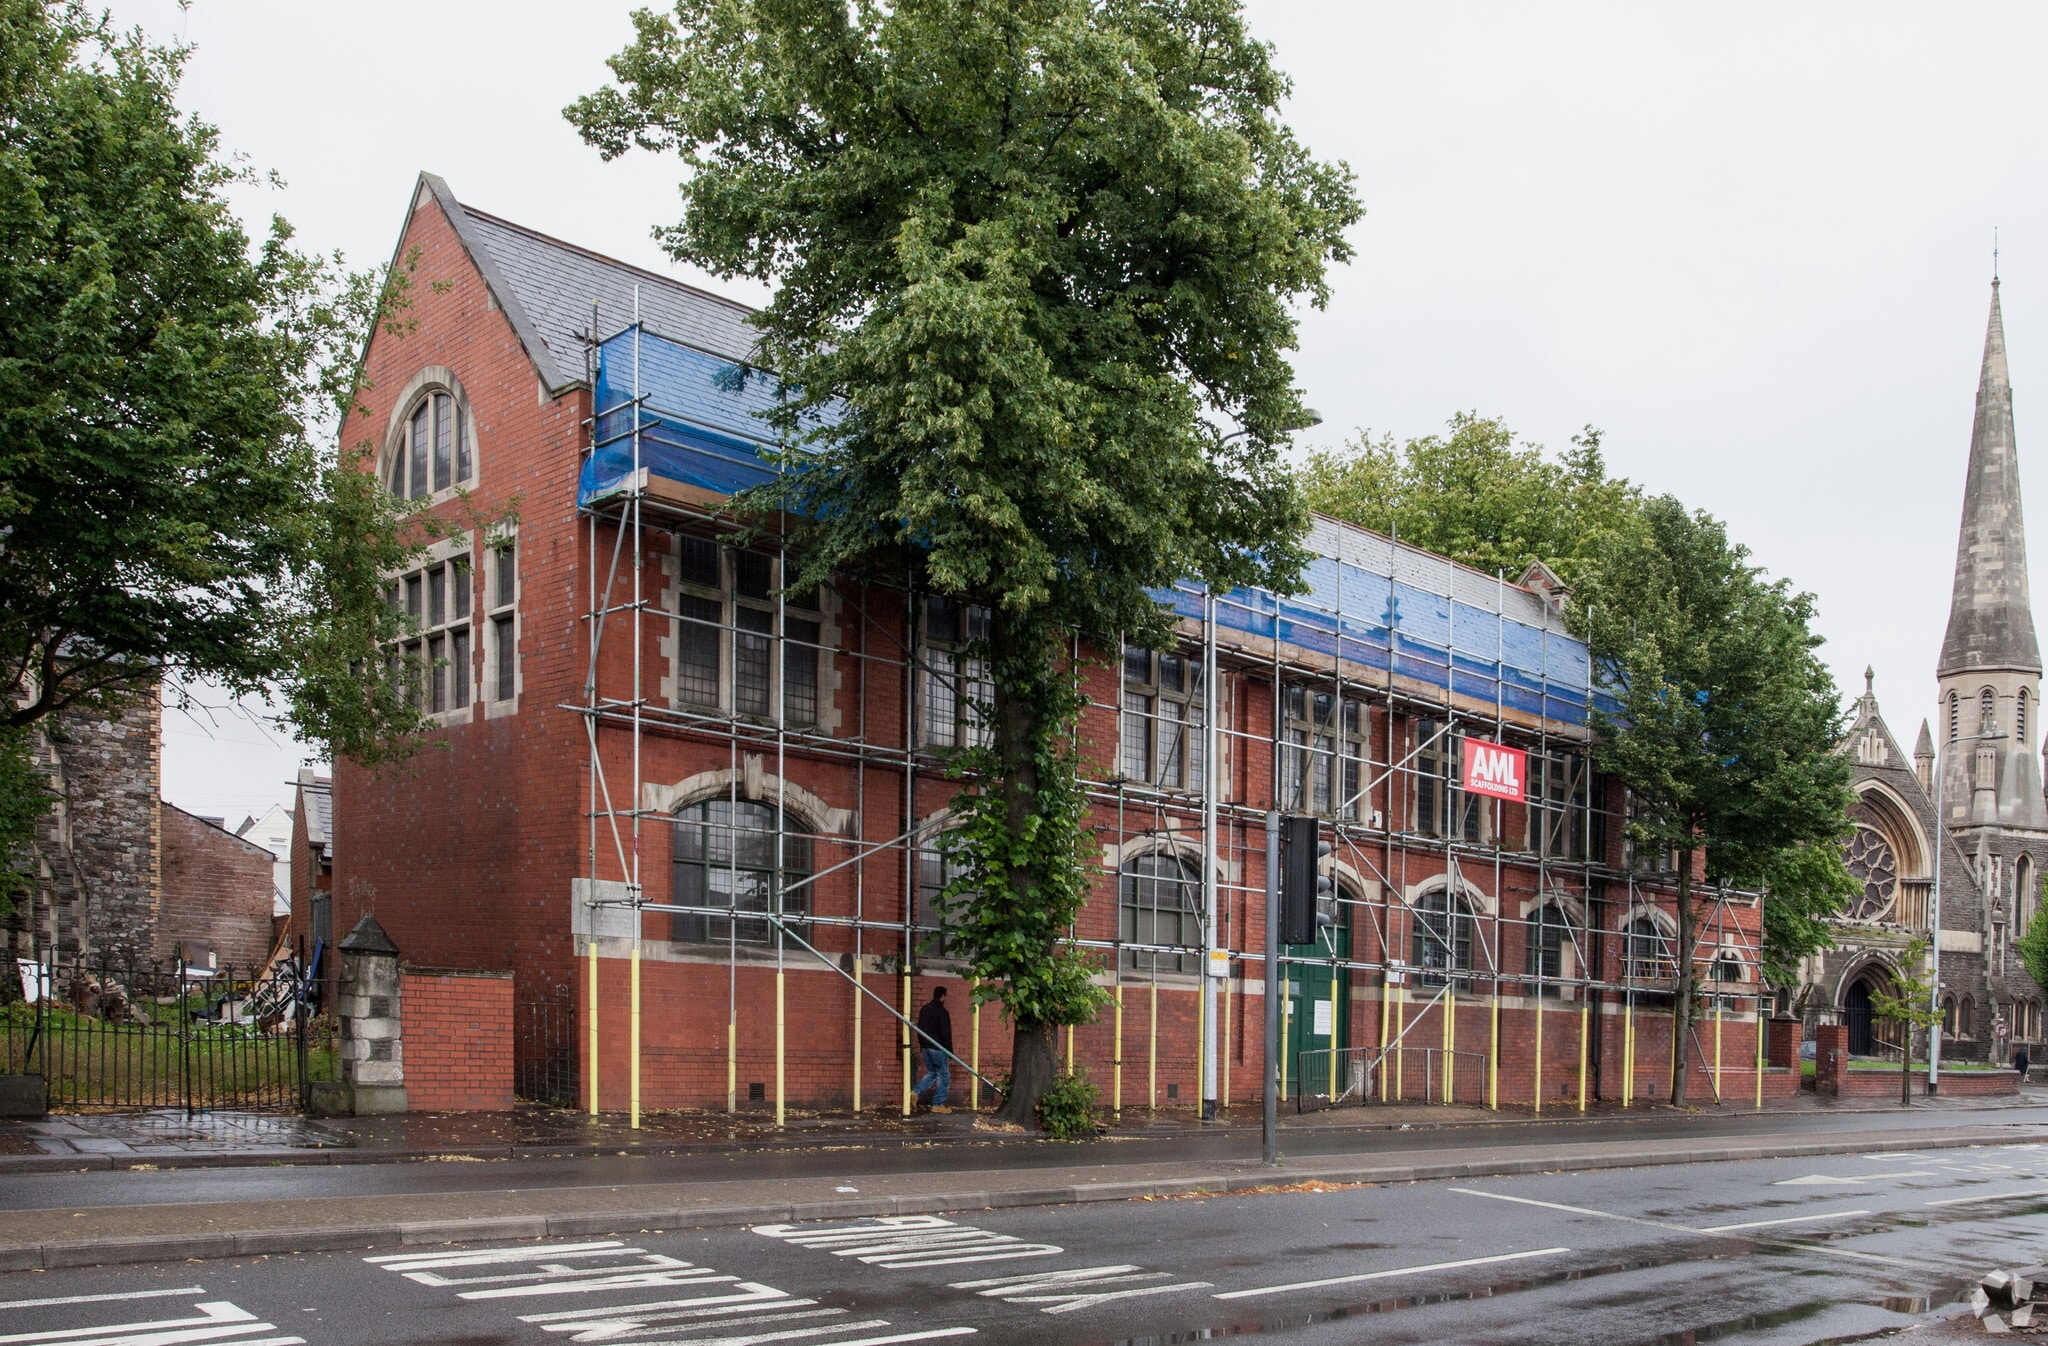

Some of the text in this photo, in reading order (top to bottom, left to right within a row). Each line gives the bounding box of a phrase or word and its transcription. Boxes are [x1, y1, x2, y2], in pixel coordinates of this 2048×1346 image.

[1471, 746, 1519, 788] AML
[1470, 778, 1519, 797] SCAFFOLDING LTD
